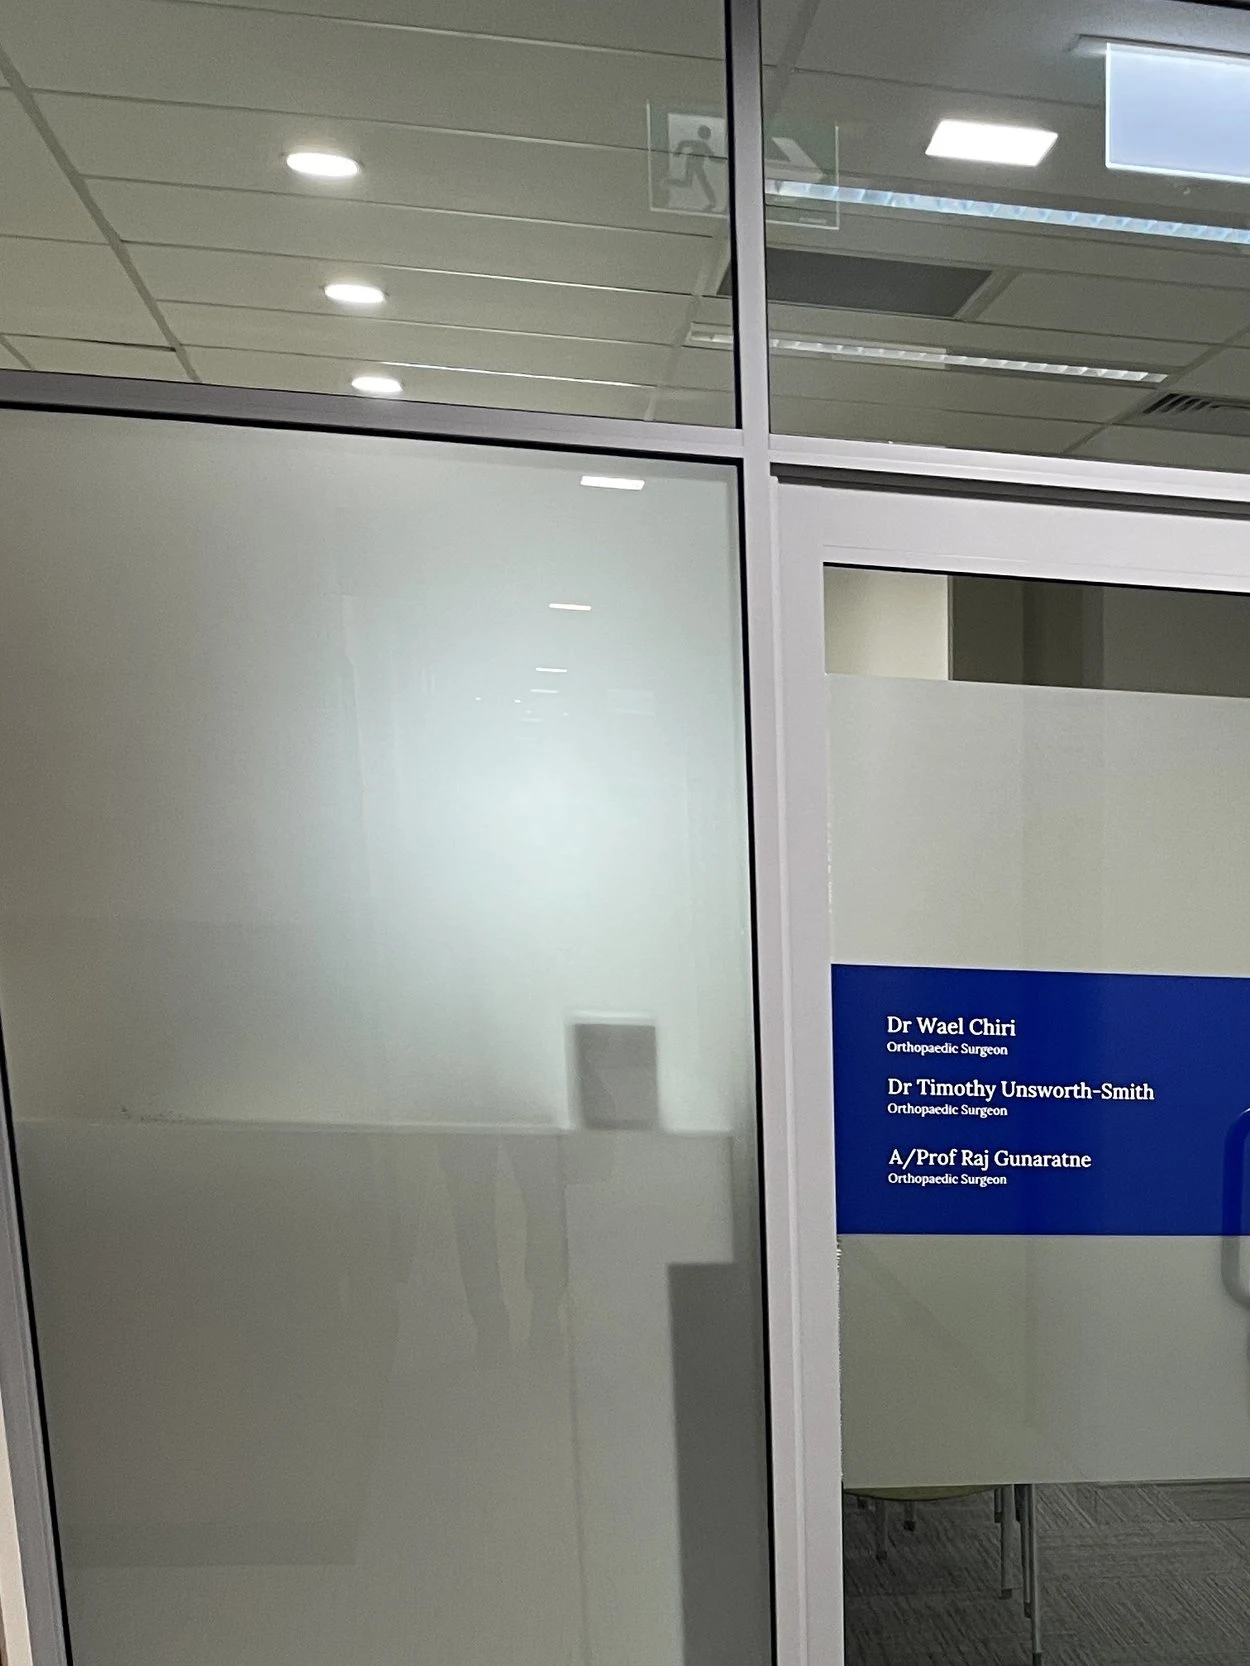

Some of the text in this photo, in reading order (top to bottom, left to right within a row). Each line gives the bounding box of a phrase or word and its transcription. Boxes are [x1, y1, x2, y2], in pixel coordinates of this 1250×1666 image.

[887, 1016, 1015, 1036] Dr Wael Chiri
[886, 1042, 1009, 1058] Orthopaedic Surgeon
[887, 1079, 1154, 1102] Dr Timothy Unsworth-Smith
[887, 1103, 1008, 1119] Orthopaedic Surgeon
[889, 1149, 1091, 1171] A/Prof Raj Gunaratne
[887, 1173, 1007, 1188] Orthopaedic Surgeon
